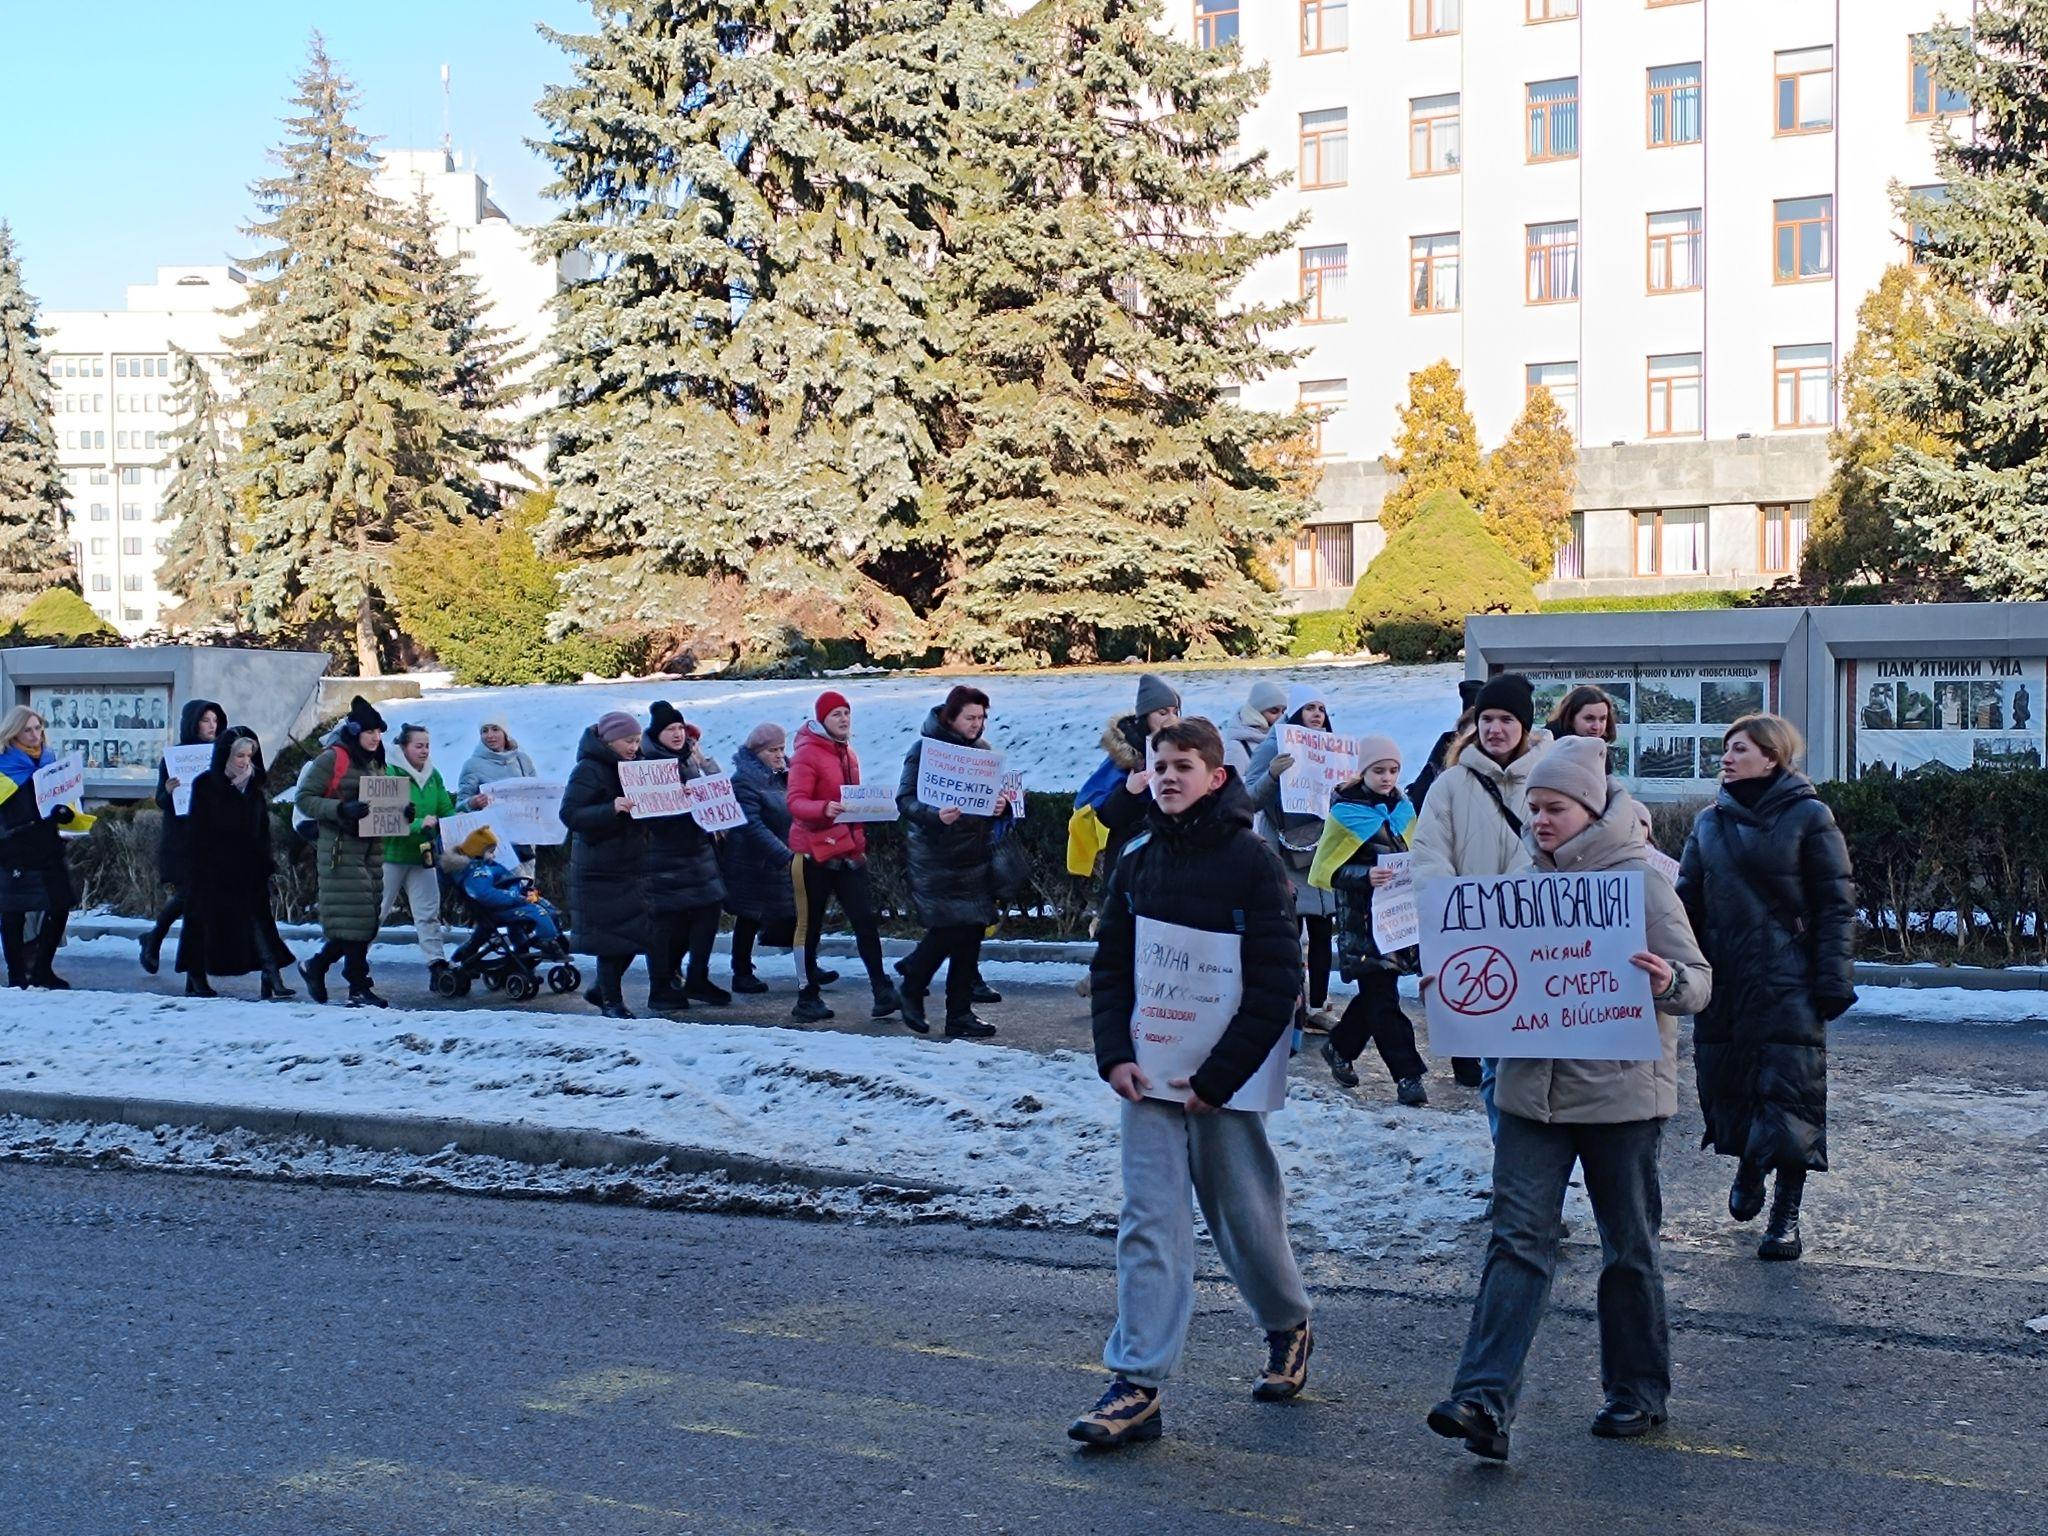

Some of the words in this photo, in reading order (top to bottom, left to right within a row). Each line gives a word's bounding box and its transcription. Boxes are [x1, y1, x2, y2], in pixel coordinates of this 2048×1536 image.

[1670, 668, 1696, 678] КЛУБУ
[1877, 659, 1982, 677] ПАМ'ЯТНИКИ
[1988, 659, 2023, 676] УПА
[923, 772, 994, 795] ЗБЕРЕЖІТЬ
[923, 787, 990, 809] ПАТРІОТІВ!
[1440, 876, 1630, 933] ДЕМОБІЛІЗАЦІЯ!
[1450, 959, 1509, 1006] 36
[1545, 970, 1619, 997] СМЕРТЬ
